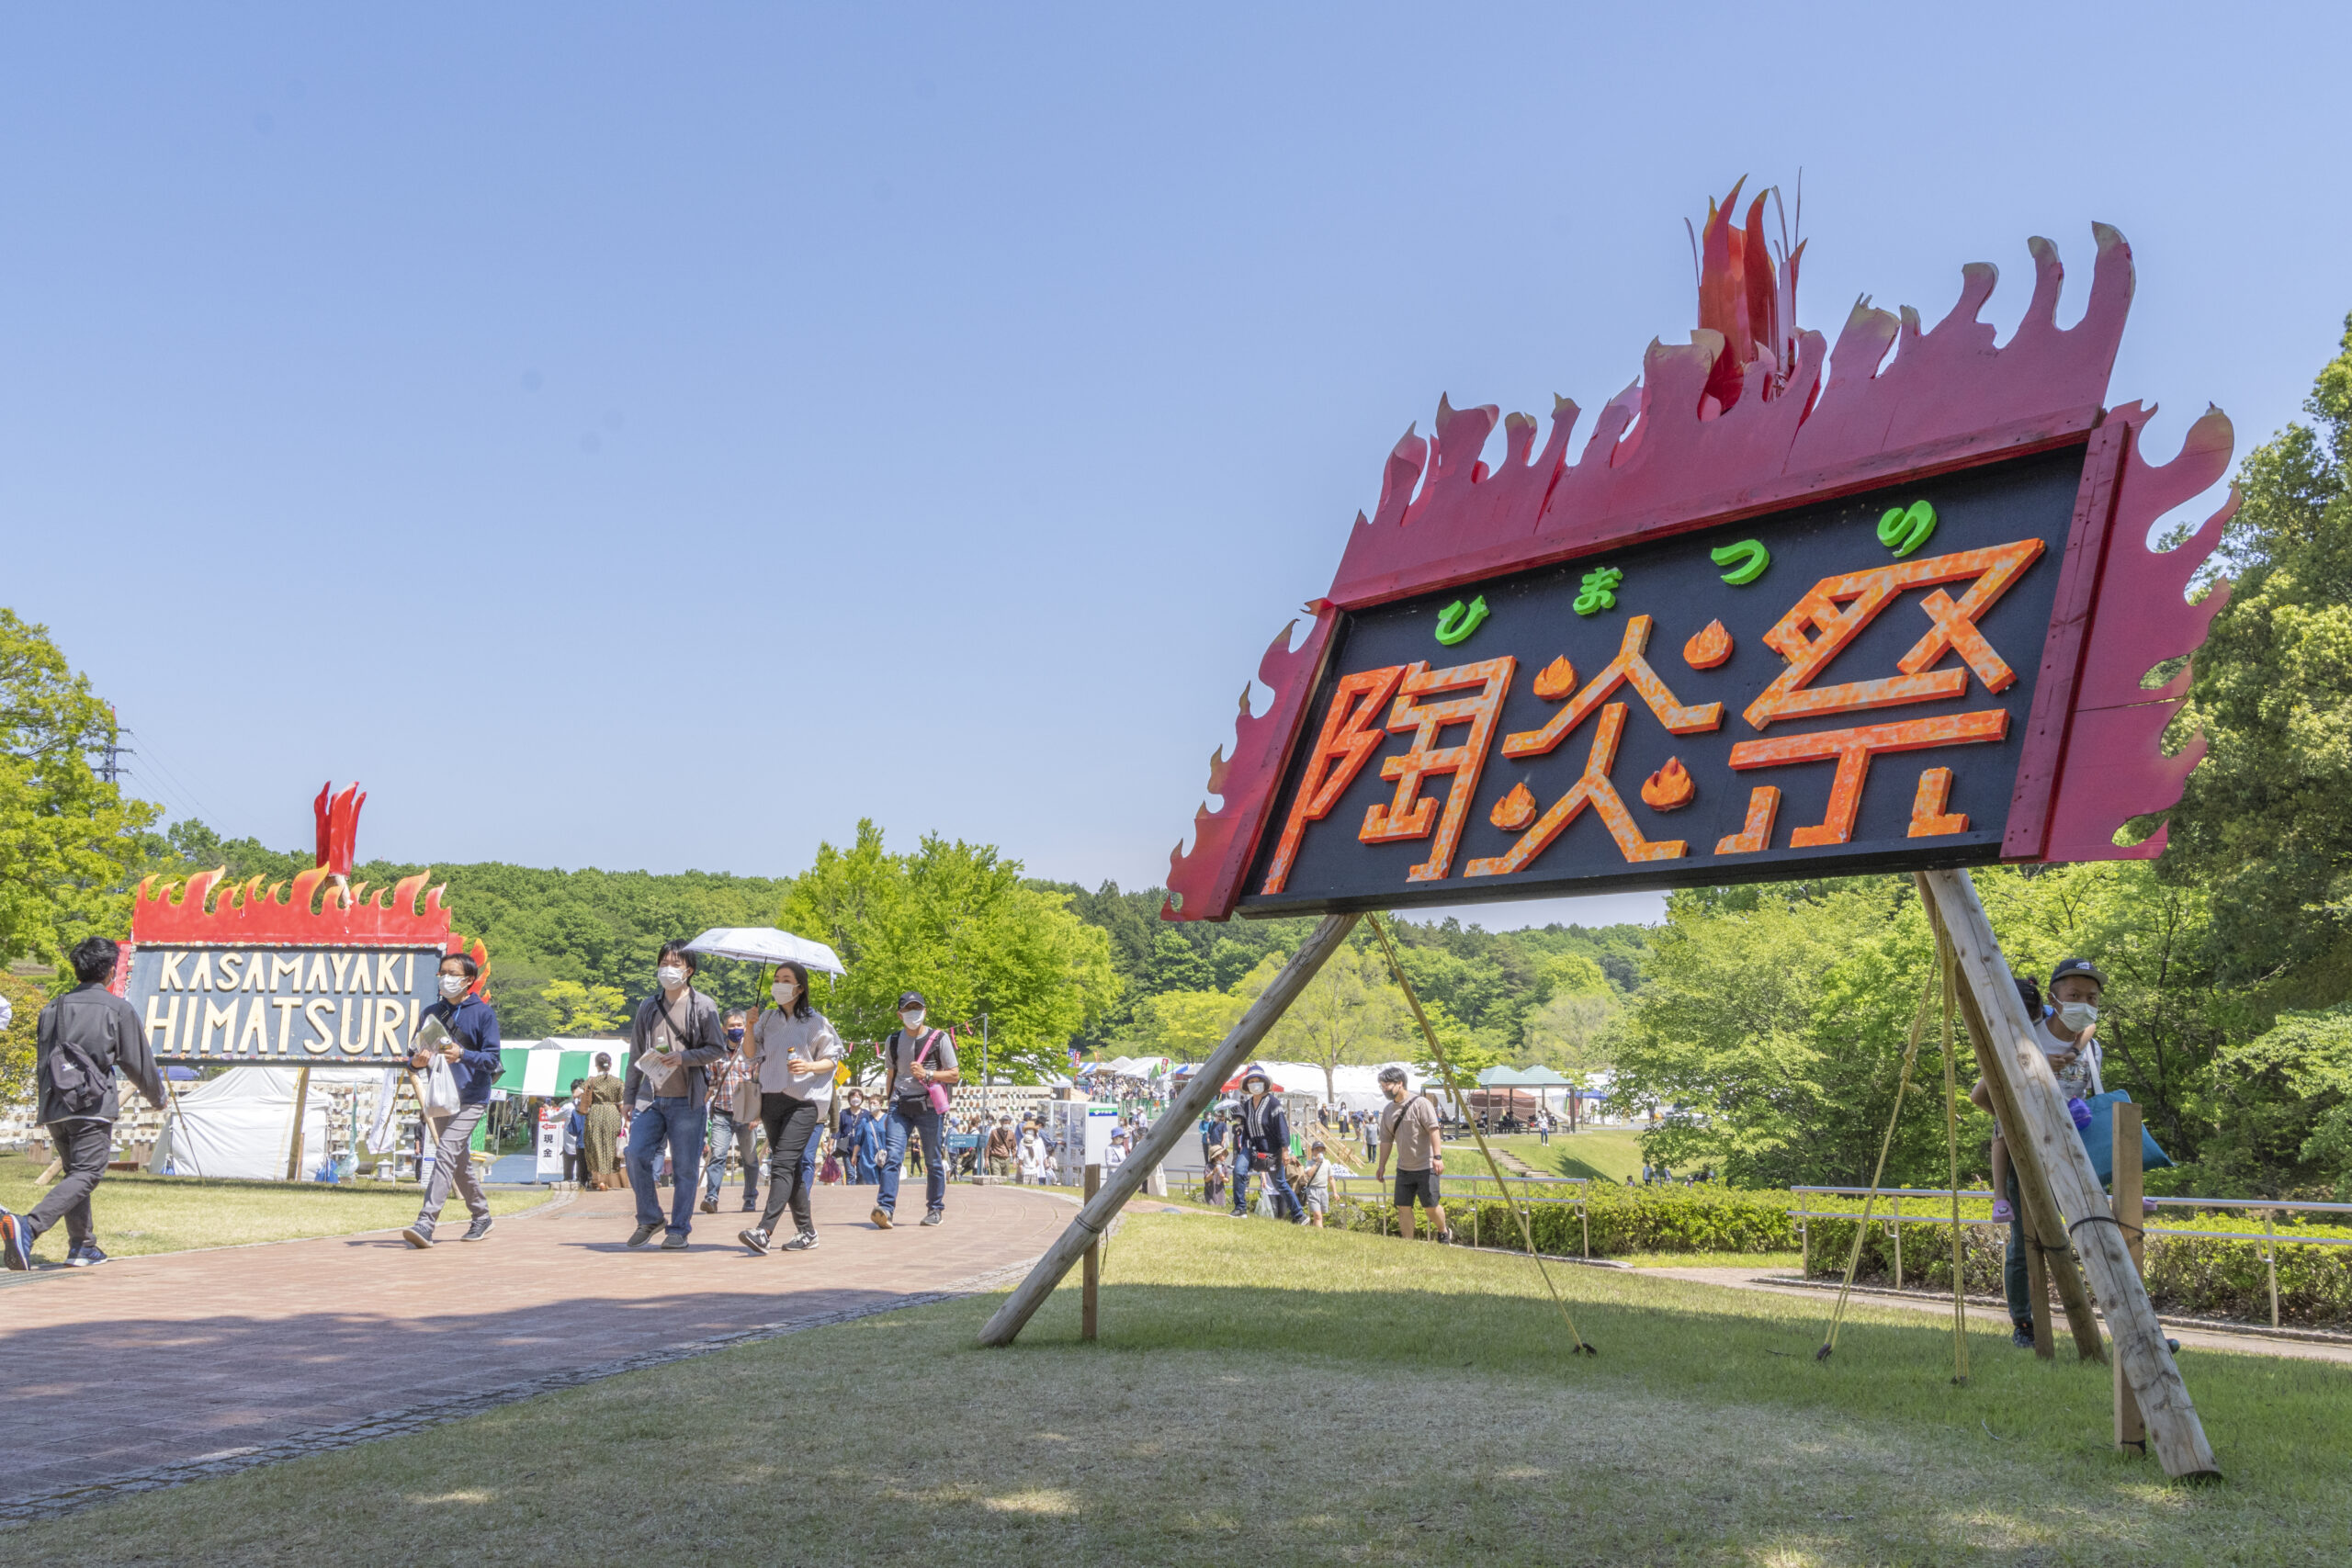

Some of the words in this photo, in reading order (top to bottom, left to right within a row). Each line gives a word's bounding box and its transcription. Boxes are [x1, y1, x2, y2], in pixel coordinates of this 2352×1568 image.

[1434, 501, 1938, 645] ひまつり
[1262, 538, 2046, 896] 陶炎祭
[159, 952, 414, 993] KASAMAYAKI
[144, 996, 420, 1055] HIMATSURI
[543, 1134, 554, 1158] 現金
